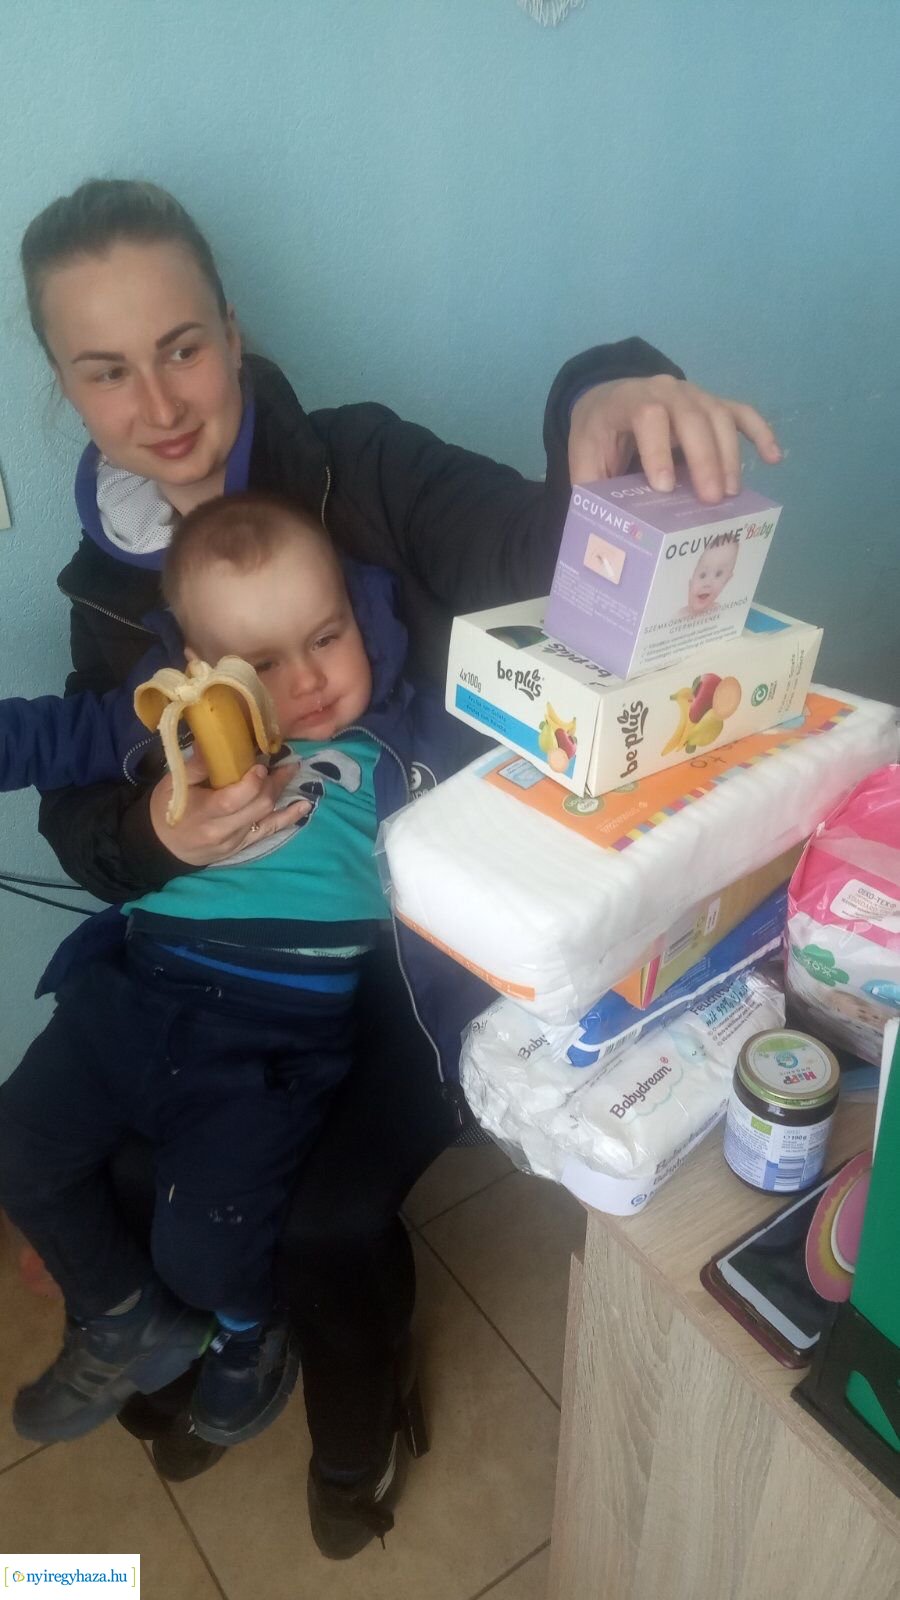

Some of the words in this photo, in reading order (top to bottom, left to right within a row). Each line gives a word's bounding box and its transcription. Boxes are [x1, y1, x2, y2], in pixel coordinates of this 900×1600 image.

[573, 494, 632, 534] OCUVANE
[665, 527, 744, 561] OCUVANE
[745, 521, 774, 541] Baby
[459, 668, 482, 693] 4x100g
[497, 660, 513, 681] be
[514, 669, 542, 699] plus
[621, 700, 645, 749] plus
[620, 749, 638, 779] be
[609, 1065, 672, 1119] Babydream
